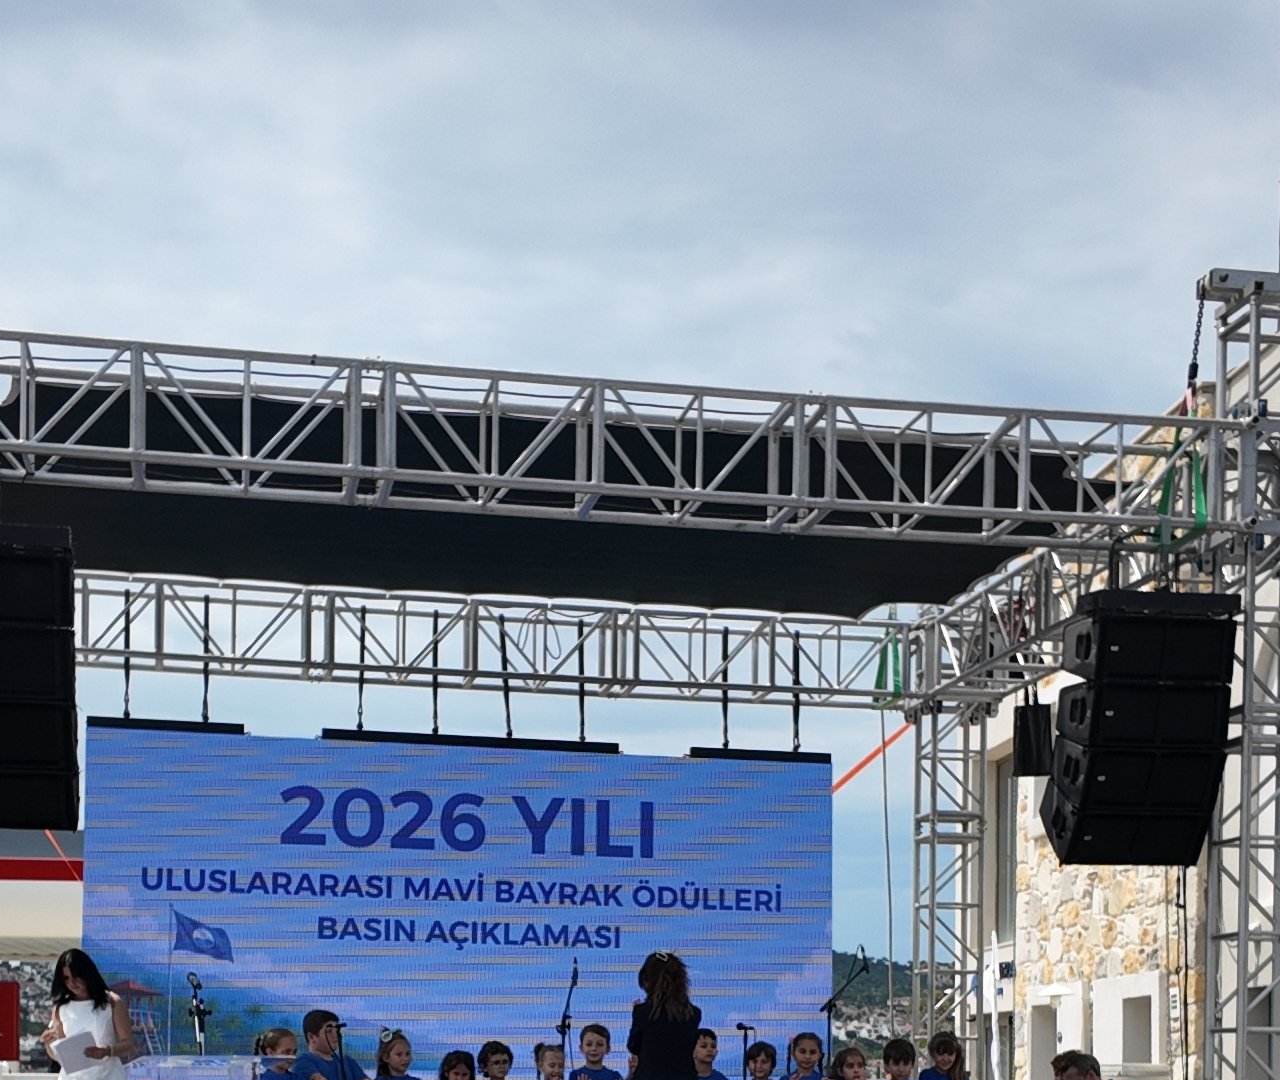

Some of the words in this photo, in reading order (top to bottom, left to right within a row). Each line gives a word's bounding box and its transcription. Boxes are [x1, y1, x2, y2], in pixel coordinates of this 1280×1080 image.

[279, 785, 486, 852] 2026
[512, 795, 655, 859] YILI
[140, 866, 392, 899] ULUSLARARASI
[403, 872, 484, 901] MAVİ
[495, 881, 624, 907] BAYRAK
[632, 879, 782, 913] ÖDÜLLERİ
[318, 916, 416, 943] BASIN
[424, 920, 621, 949] AÇIKLAMASI
